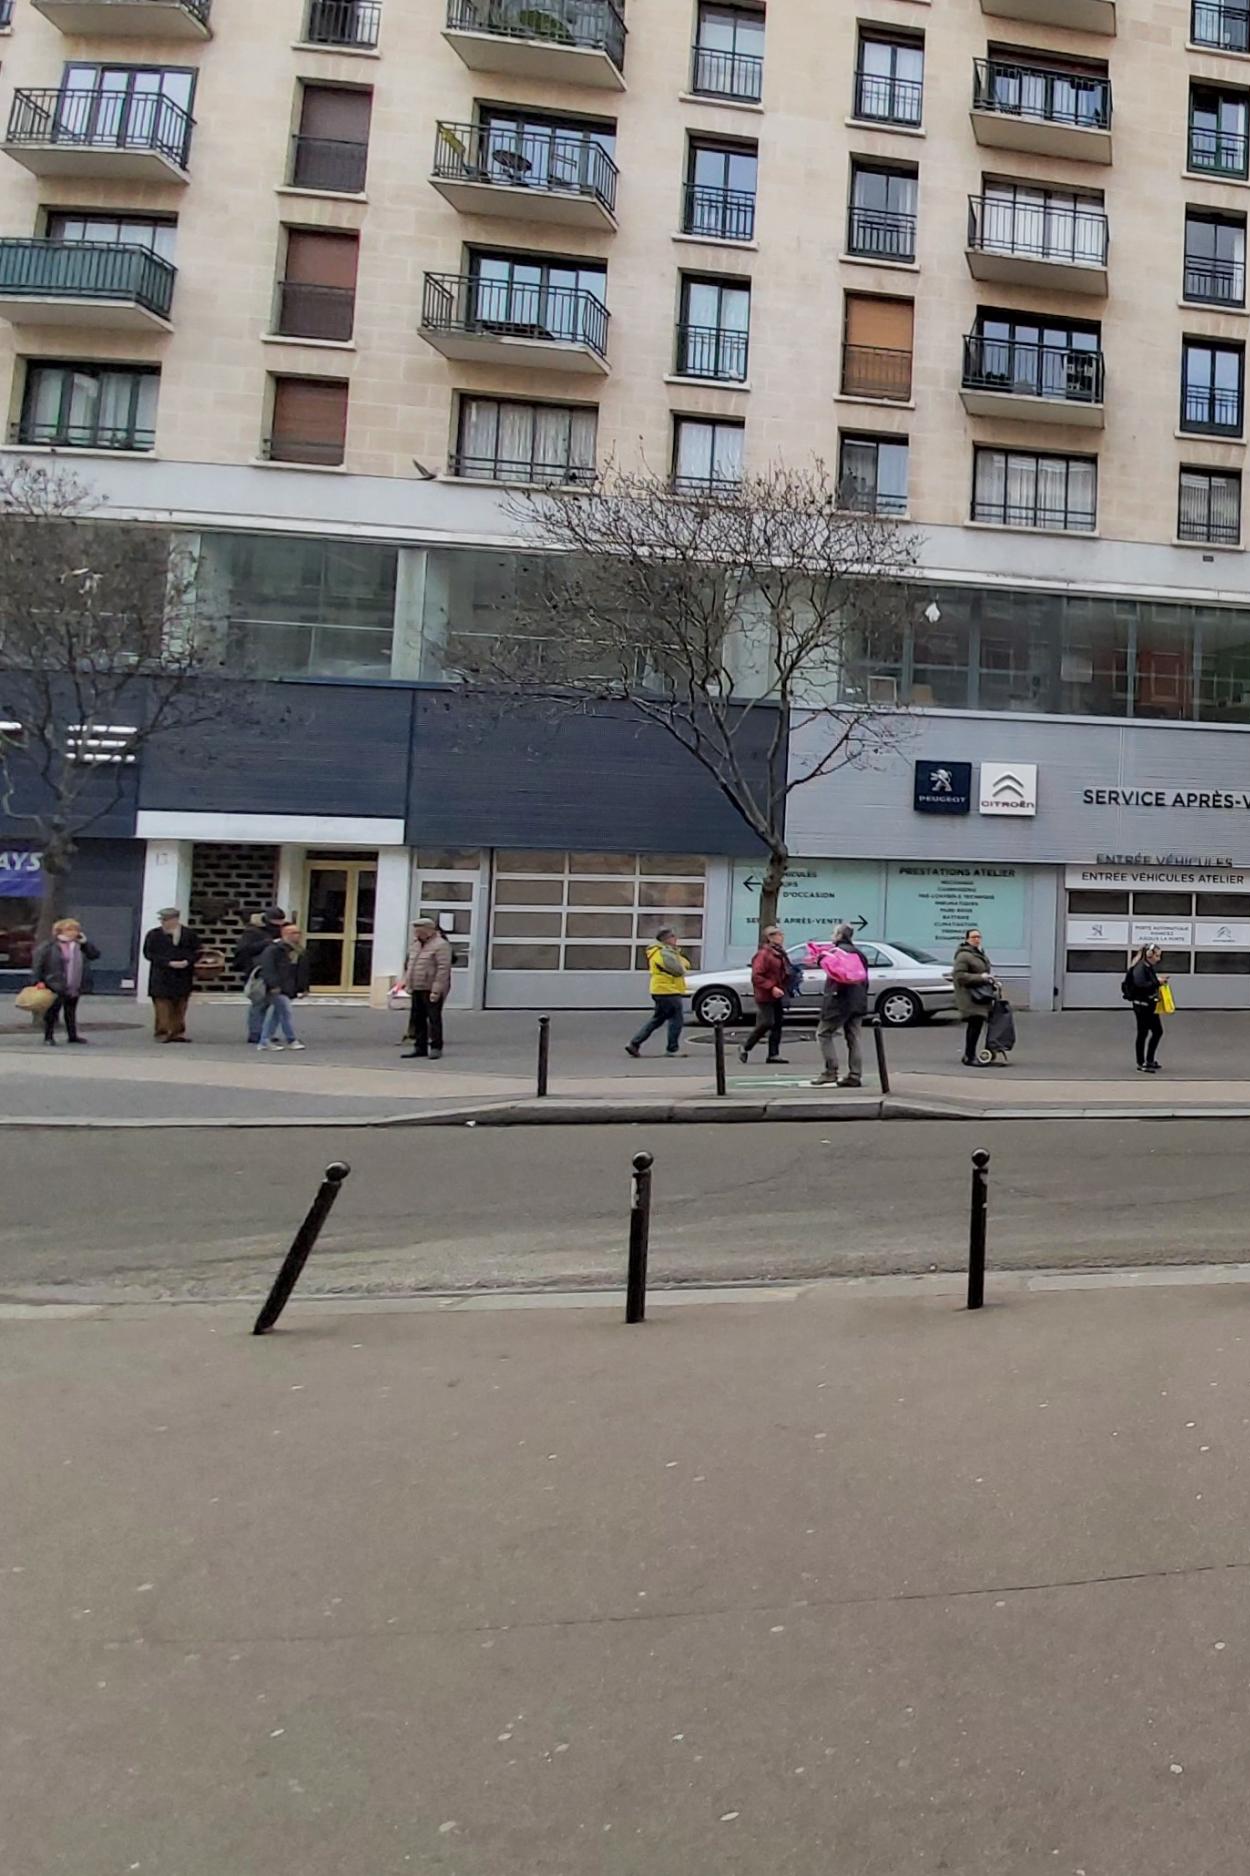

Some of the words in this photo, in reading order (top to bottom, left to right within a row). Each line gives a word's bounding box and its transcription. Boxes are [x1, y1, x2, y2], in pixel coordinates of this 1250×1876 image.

[918, 795, 967, 803] PEUGEOT
[1083, 789, 1165, 807] SERVICE
[981, 800, 1035, 809] CITROËN
[899, 867, 970, 877] PRESTATIONS
[973, 868, 1016, 878] ATELIER
[1131, 872, 1195, 884] VÉHICULES
[1198, 874, 1245, 885] ATELIER
[783, 891, 836, 899] D'OCCASION
[784, 916, 844, 924] APRÈS-VENTE
